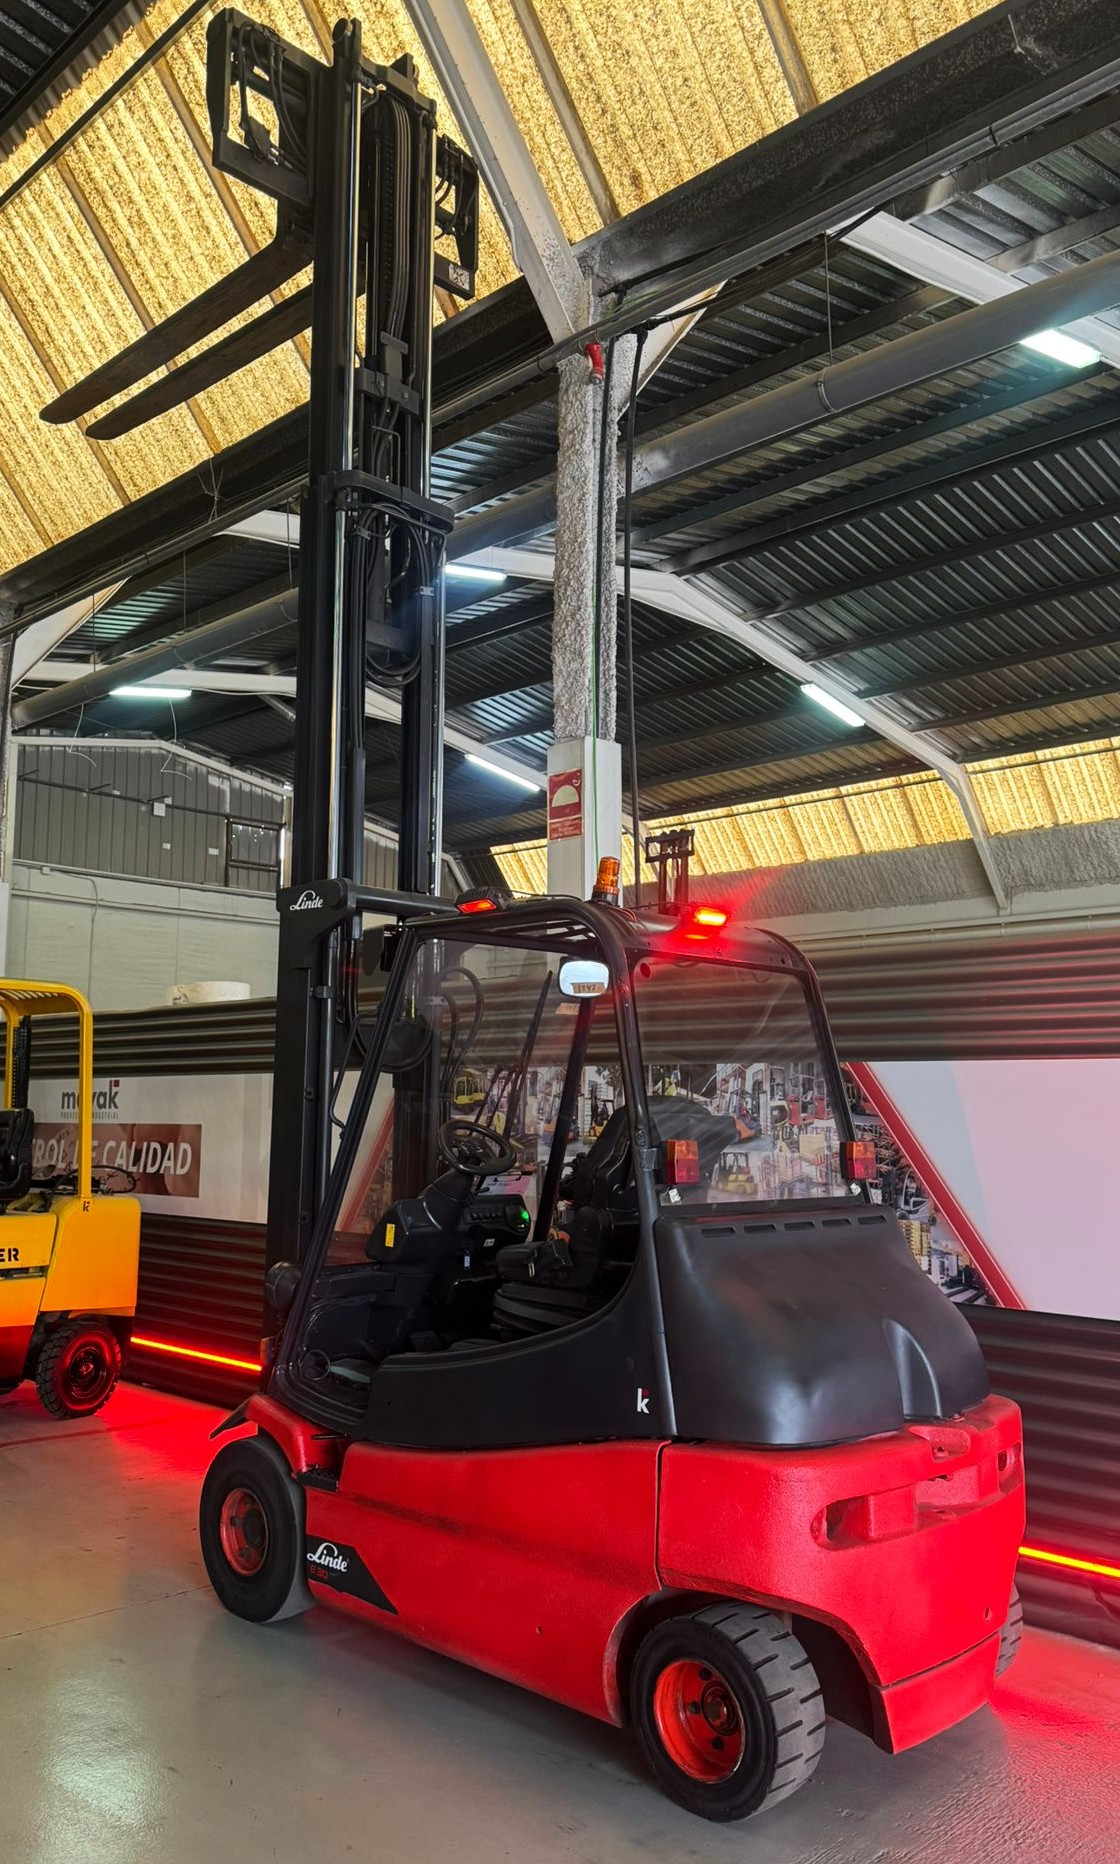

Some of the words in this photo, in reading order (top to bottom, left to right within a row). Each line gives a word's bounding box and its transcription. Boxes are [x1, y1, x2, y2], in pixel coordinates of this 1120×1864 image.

[289, 890, 324, 911] Linde
[102, 1140, 193, 1175] CALIDAD
[637, 1387, 650, 1414] k
[306, 1542, 348, 1573] Linde
